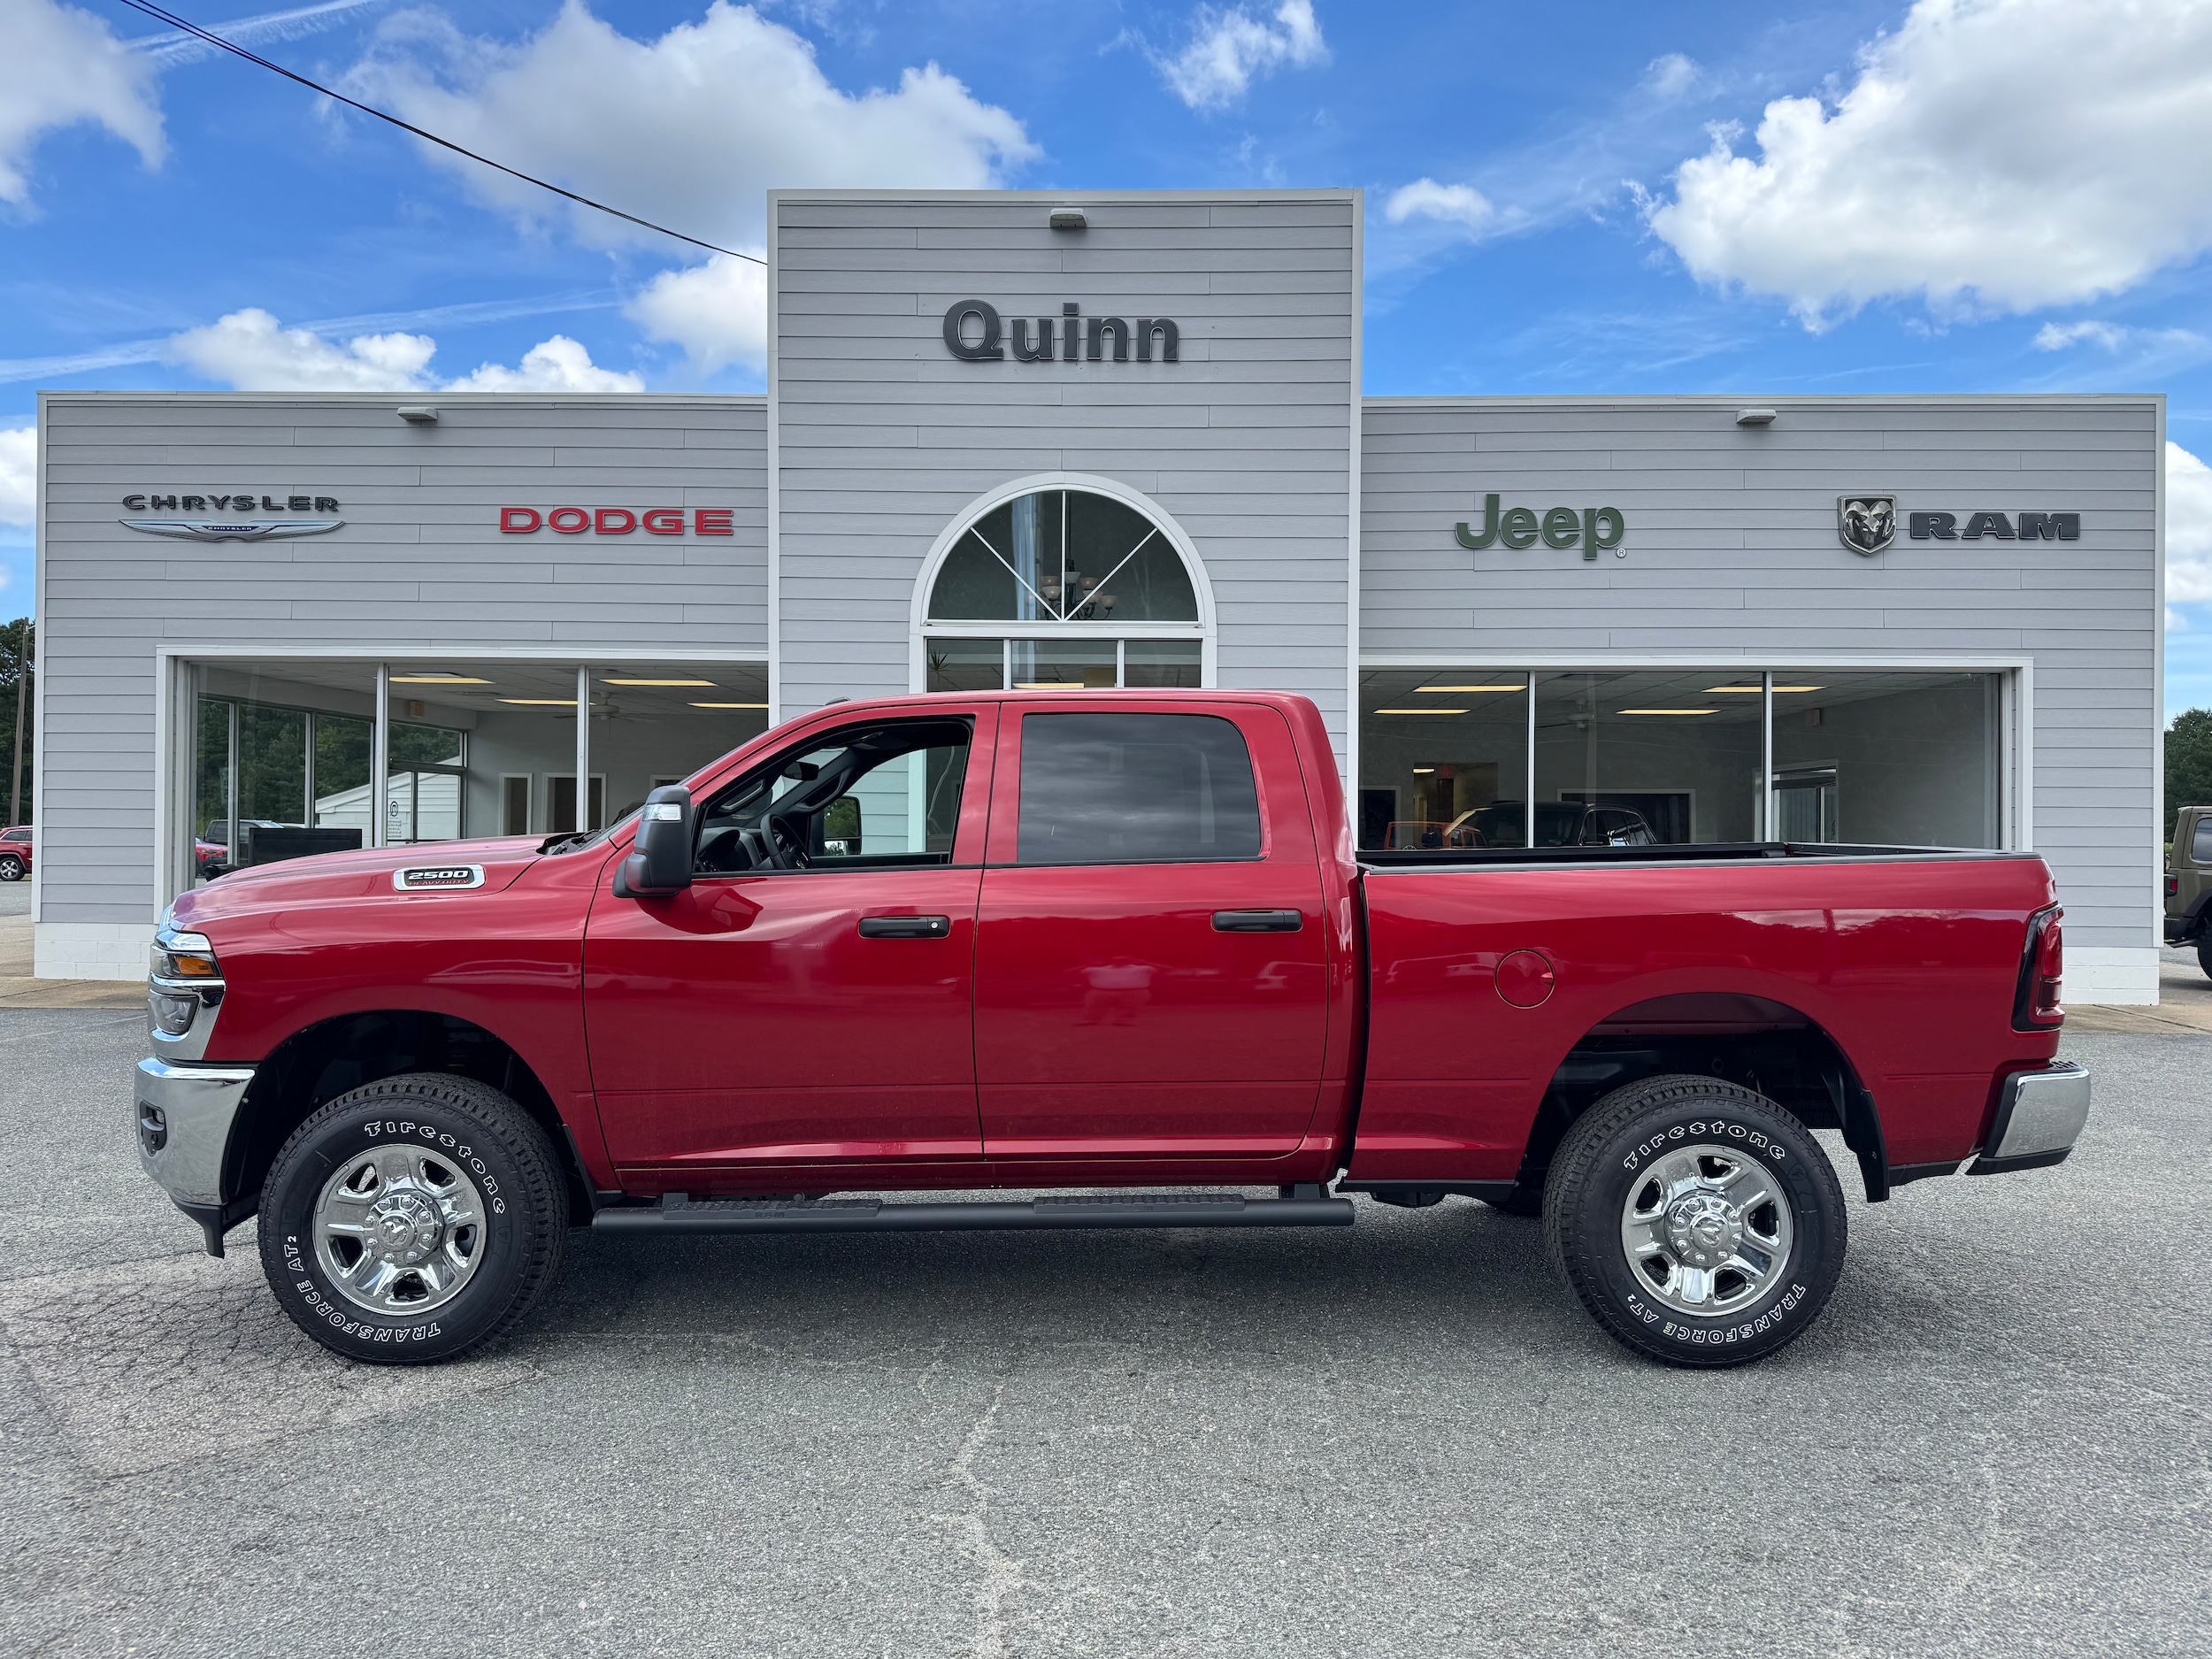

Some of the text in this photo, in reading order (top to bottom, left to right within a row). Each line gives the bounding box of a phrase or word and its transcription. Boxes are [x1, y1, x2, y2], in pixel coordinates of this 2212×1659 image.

[942, 298, 1179, 362] Quinn
[122, 495, 339, 512] CHRYSLER
[499, 507, 734, 535] DODGE
[1909, 511, 2081, 540] RAM
[408, 870, 469, 880] 2500
[365, 1120, 506, 1215] Firestone
[1623, 1120, 1786, 1171] Firestone
[296, 1279, 442, 1342] TRANSFORCE
[1663, 1283, 1806, 1344] TRANSFORCE
